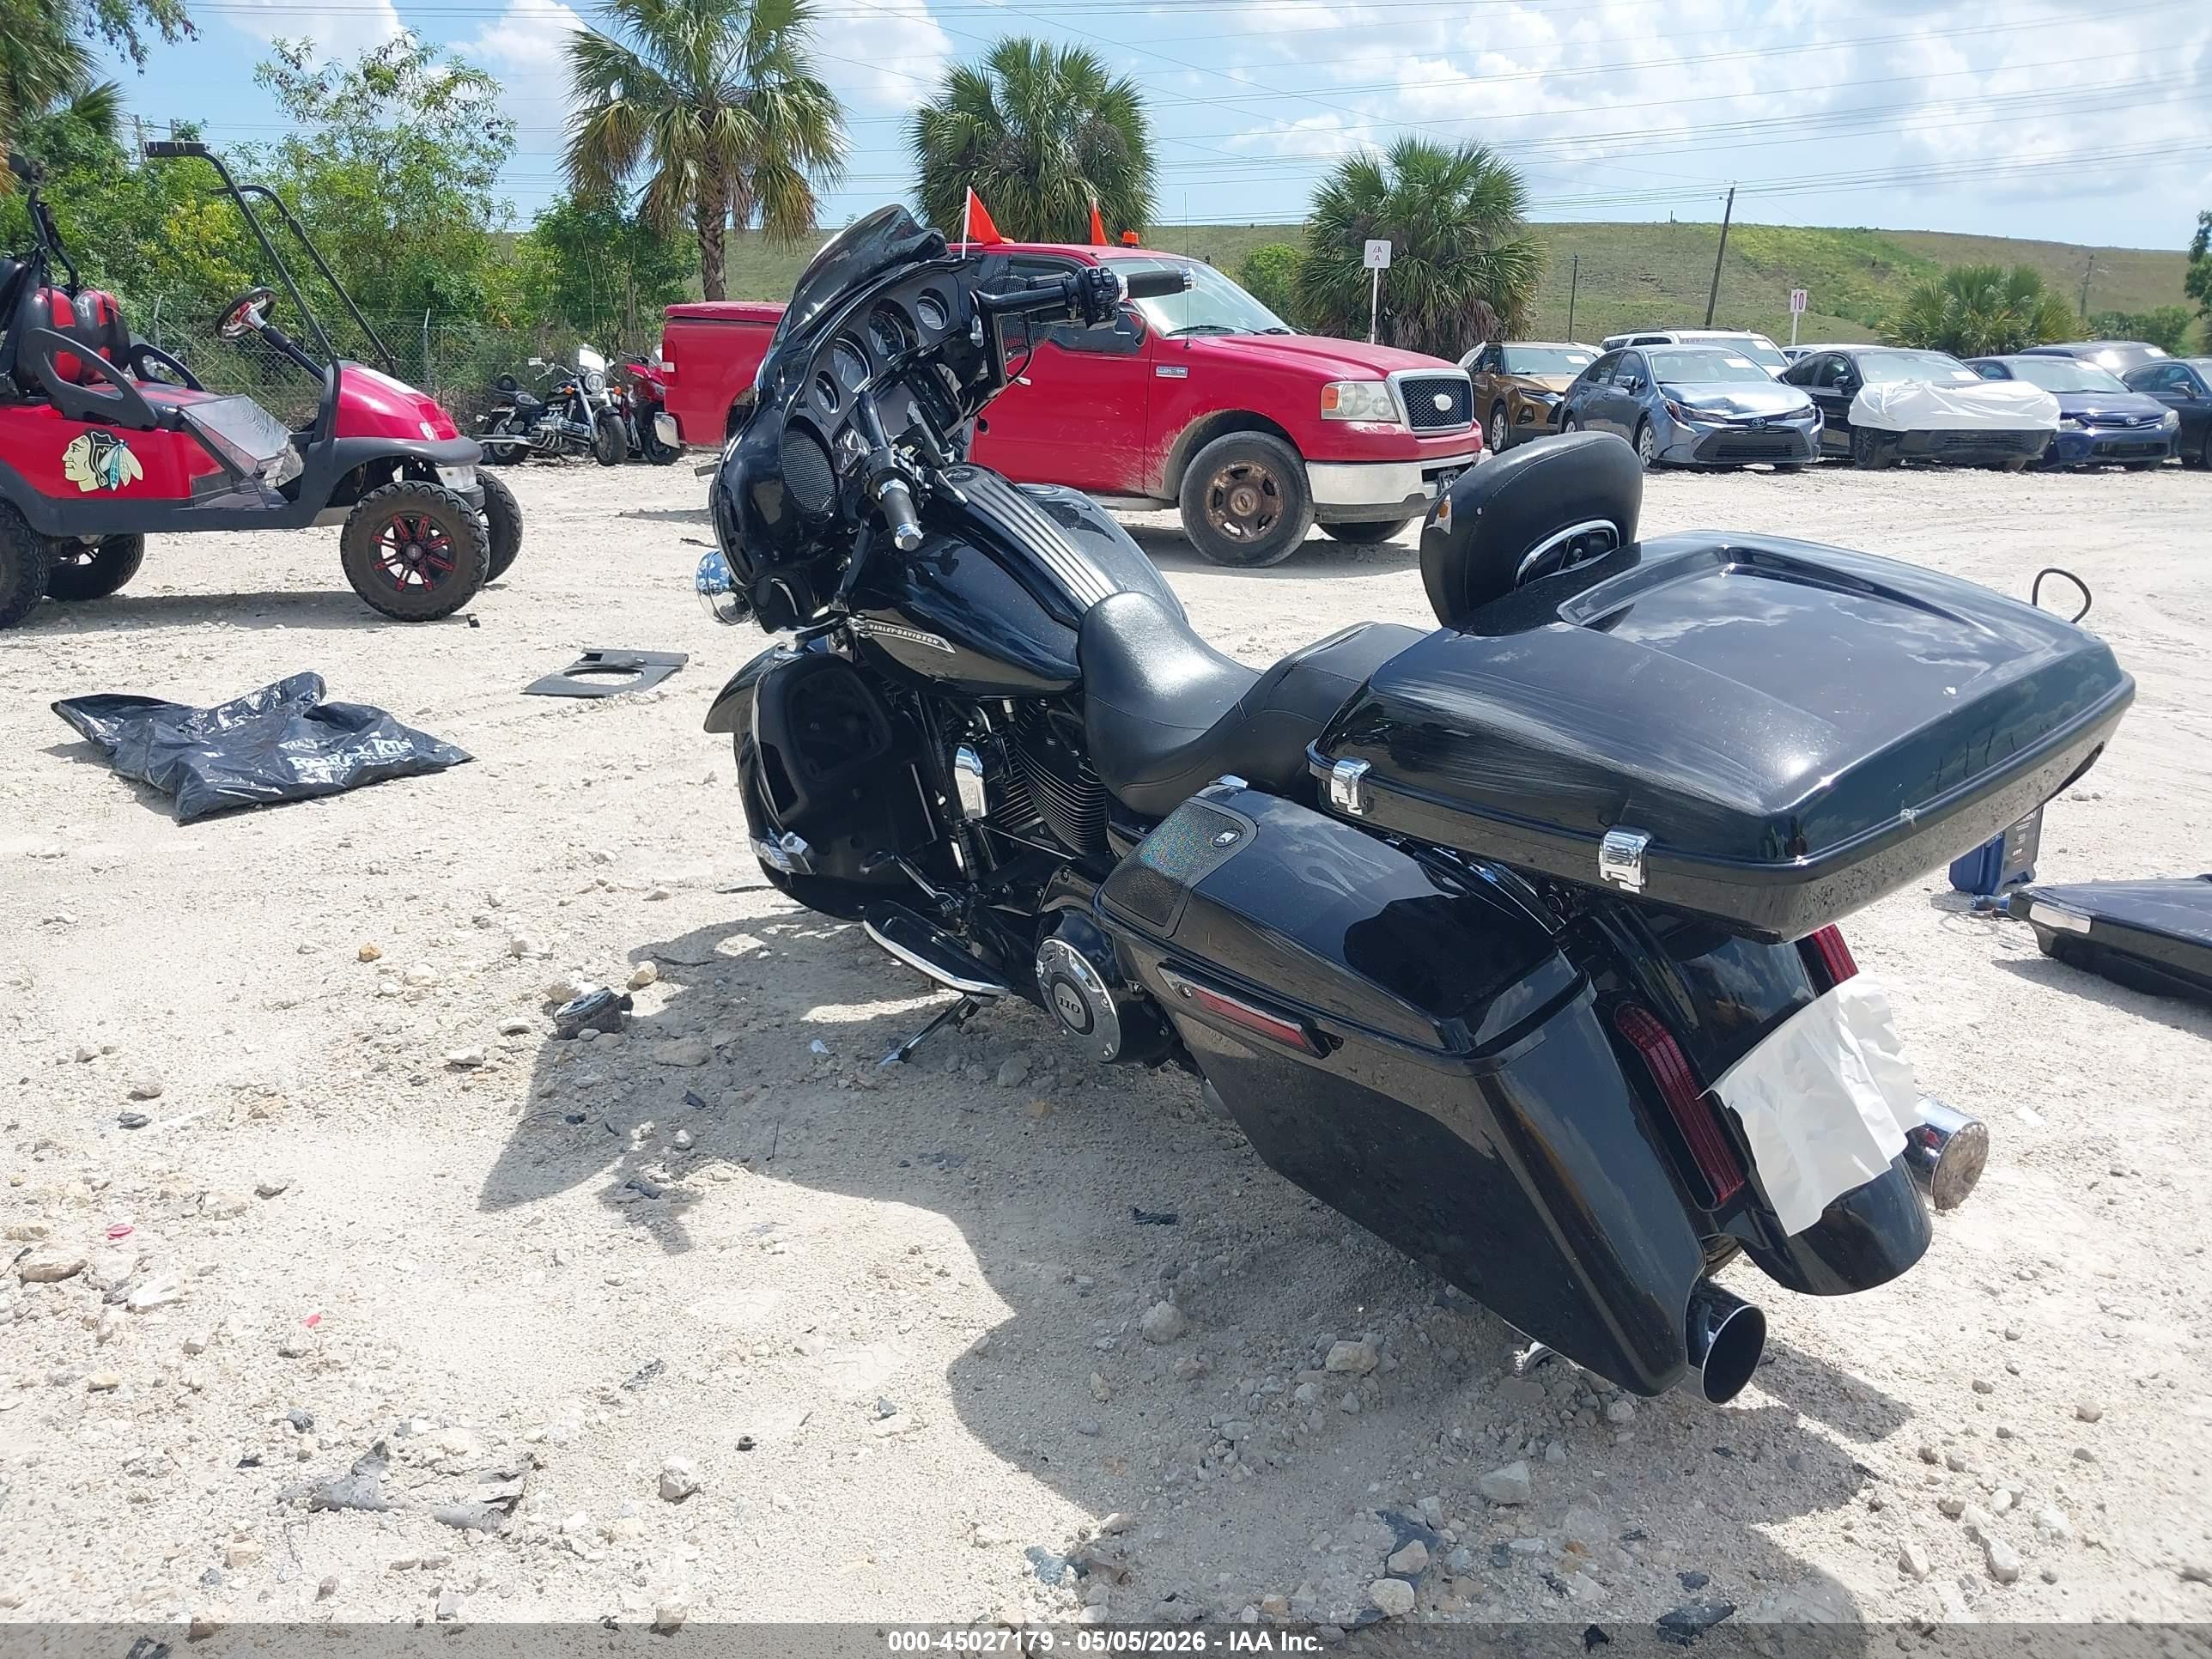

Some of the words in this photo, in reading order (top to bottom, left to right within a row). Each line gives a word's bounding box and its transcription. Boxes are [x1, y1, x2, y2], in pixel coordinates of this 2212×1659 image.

[1793, 292, 1805, 310] 10
[868, 623, 939, 645] HARLEY-DAVIDSON
[1058, 995, 1081, 1014] 110
